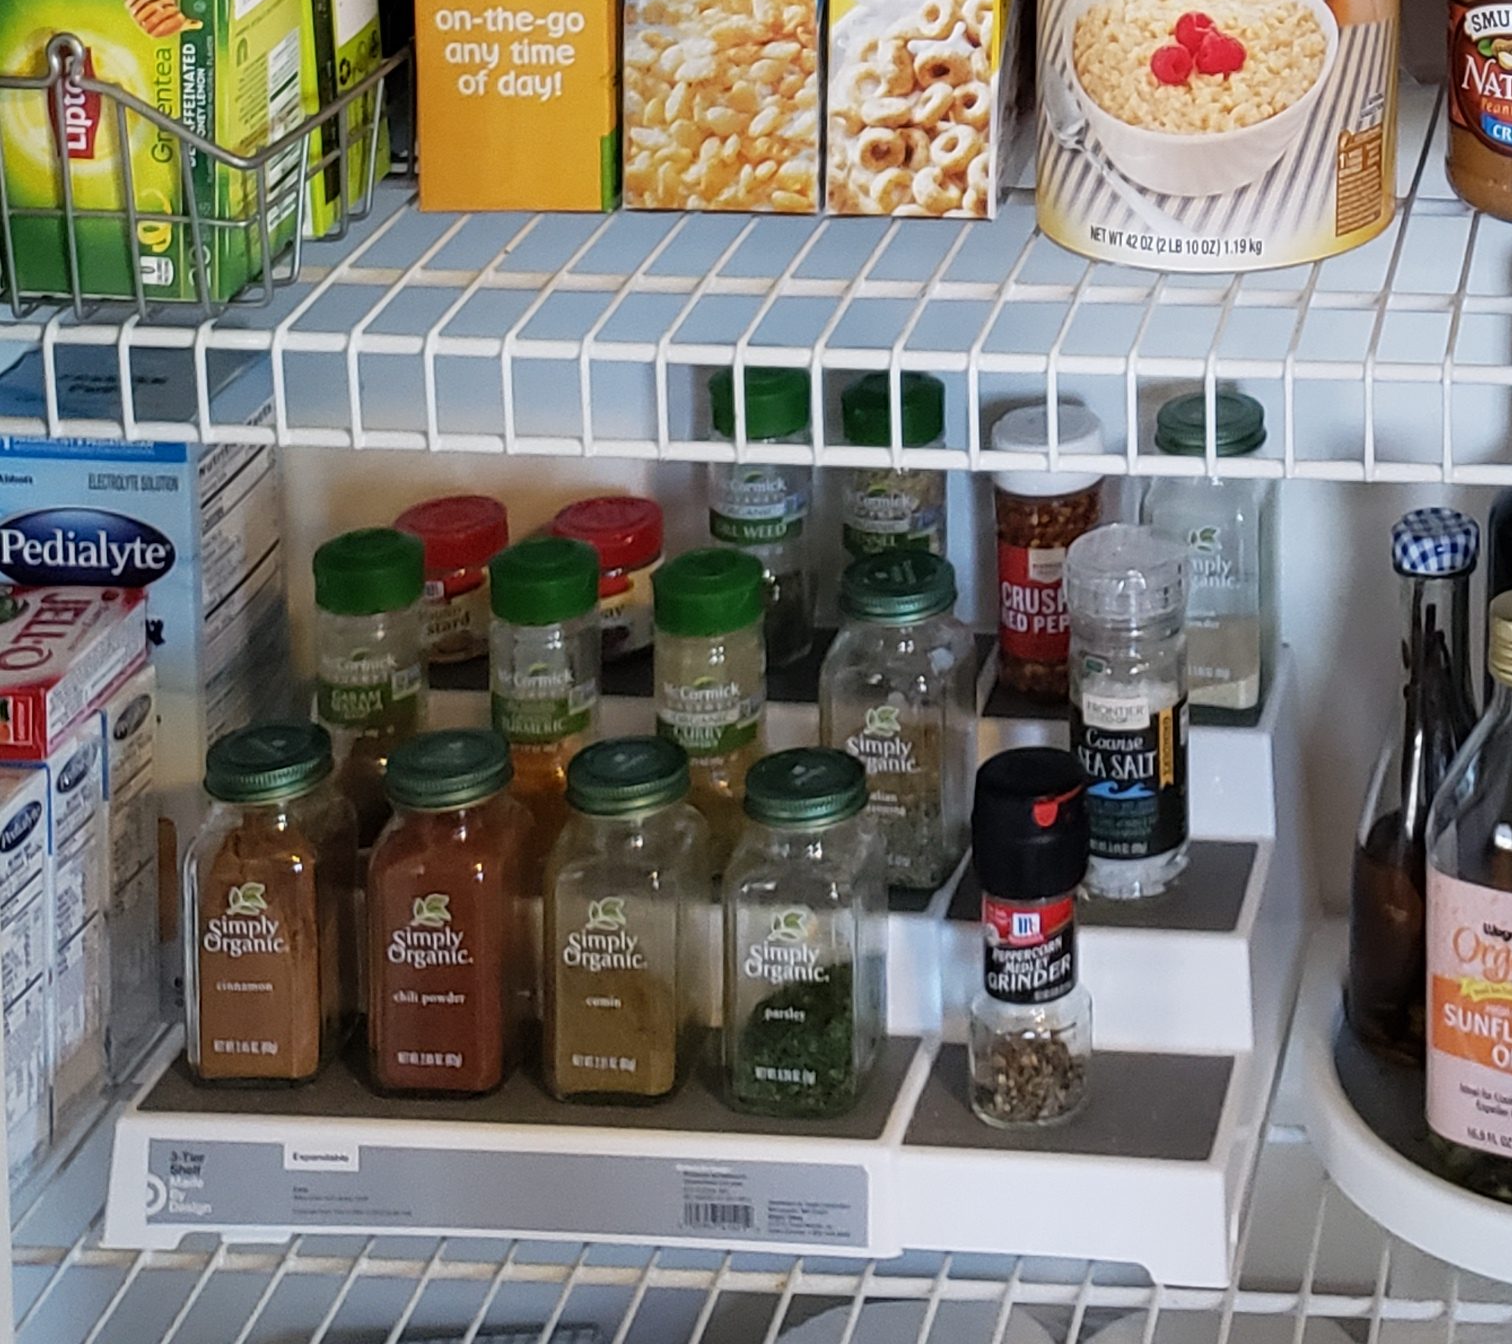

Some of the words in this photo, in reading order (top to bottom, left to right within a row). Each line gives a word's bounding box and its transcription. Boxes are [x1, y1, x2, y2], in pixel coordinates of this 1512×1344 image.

[435, 6, 586, 34] on-the-go
[445, 43, 500, 70] any
[510, 39, 576, 65] time
[457, 71, 489, 96] of
[497, 70, 564, 102] day!
[0, 527, 167, 576] Pedialyte
[1113, 750, 1158, 781] SALT
[209, 914, 279, 939] Simply
[392, 926, 464, 951] Simply
[568, 930, 638, 954] Simply
[749, 940, 820, 966] Simply
[988, 954, 1073, 992] GRINDER
[216, 981, 274, 993] cinnamon
[393, 990, 419, 1003] chili
[421, 991, 466, 1005] powder
[585, 994, 622, 1009] cumin
[764, 1008, 806, 1023] parsley
